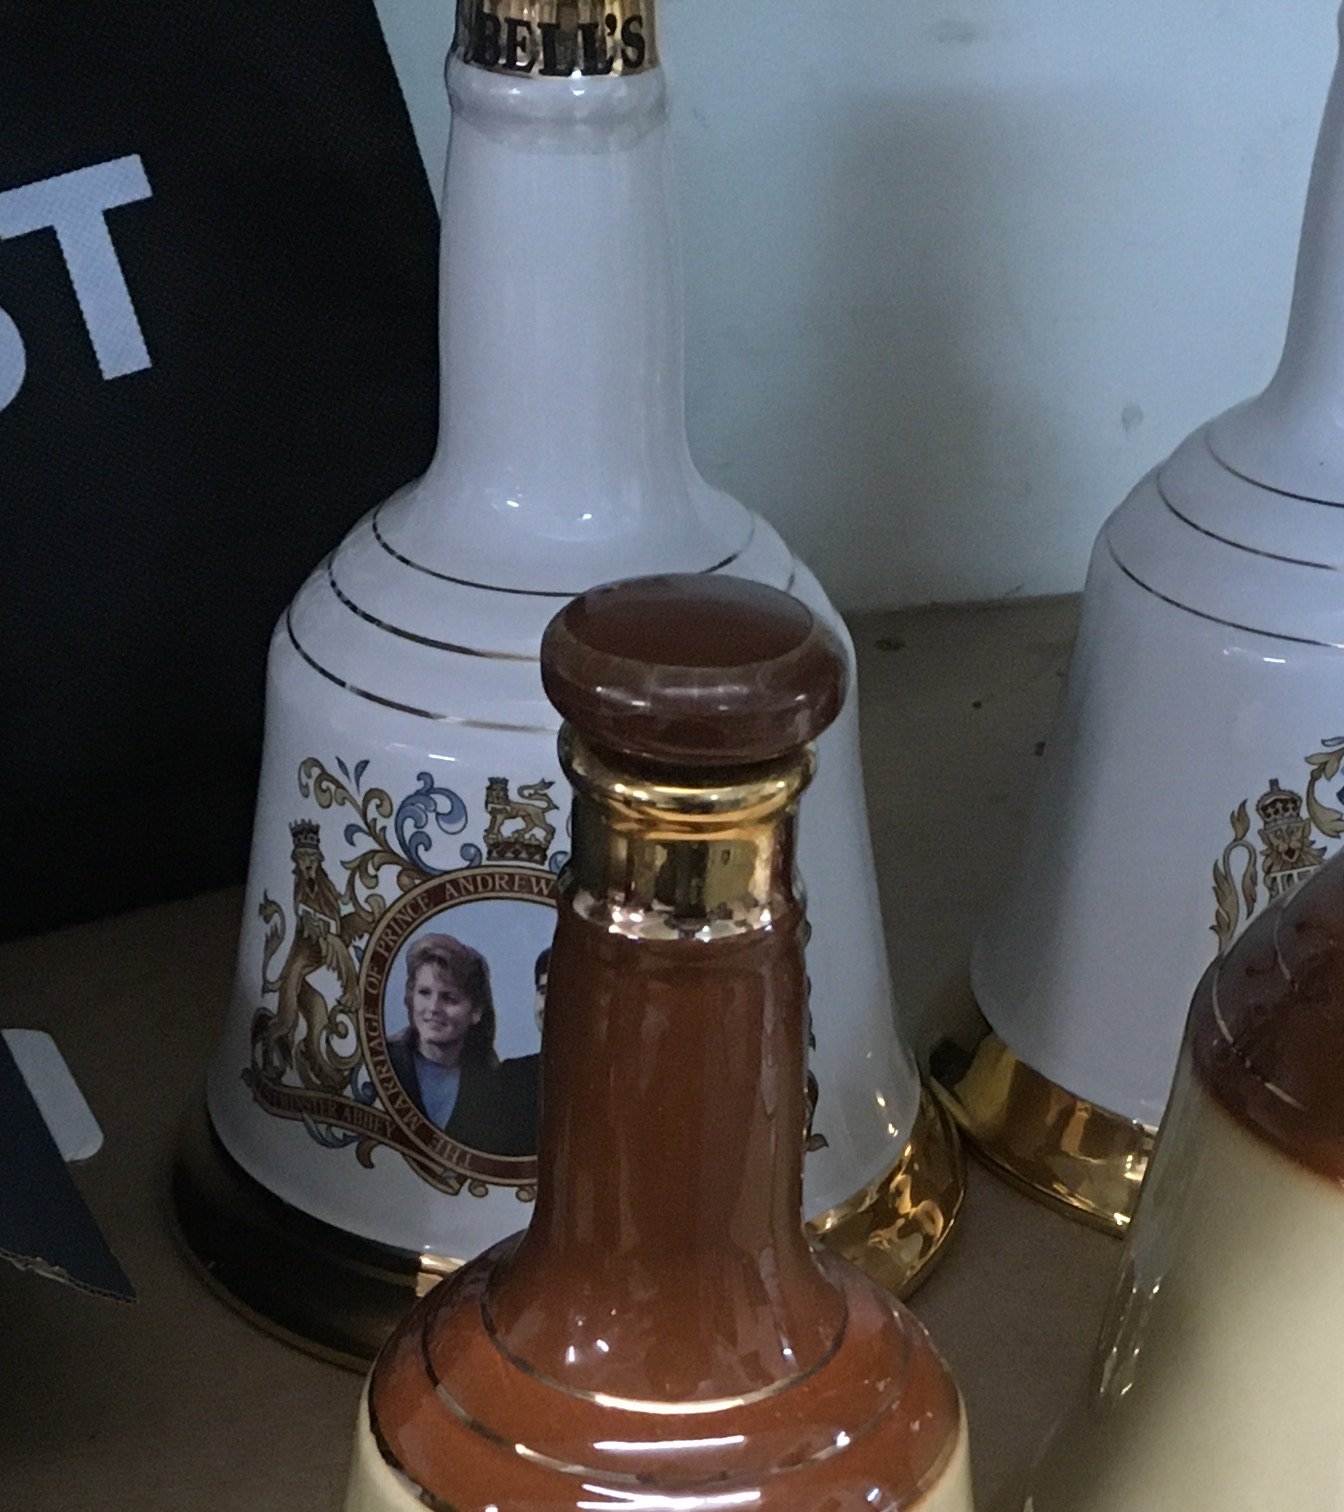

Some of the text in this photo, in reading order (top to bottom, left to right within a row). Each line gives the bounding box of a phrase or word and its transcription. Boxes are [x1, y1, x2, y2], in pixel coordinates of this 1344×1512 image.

[463, 13, 645, 77] BELL'S
[365, 962, 384, 996] OF
[377, 892, 434, 956] PRINCE
[445, 872, 555, 900] ANDREW
